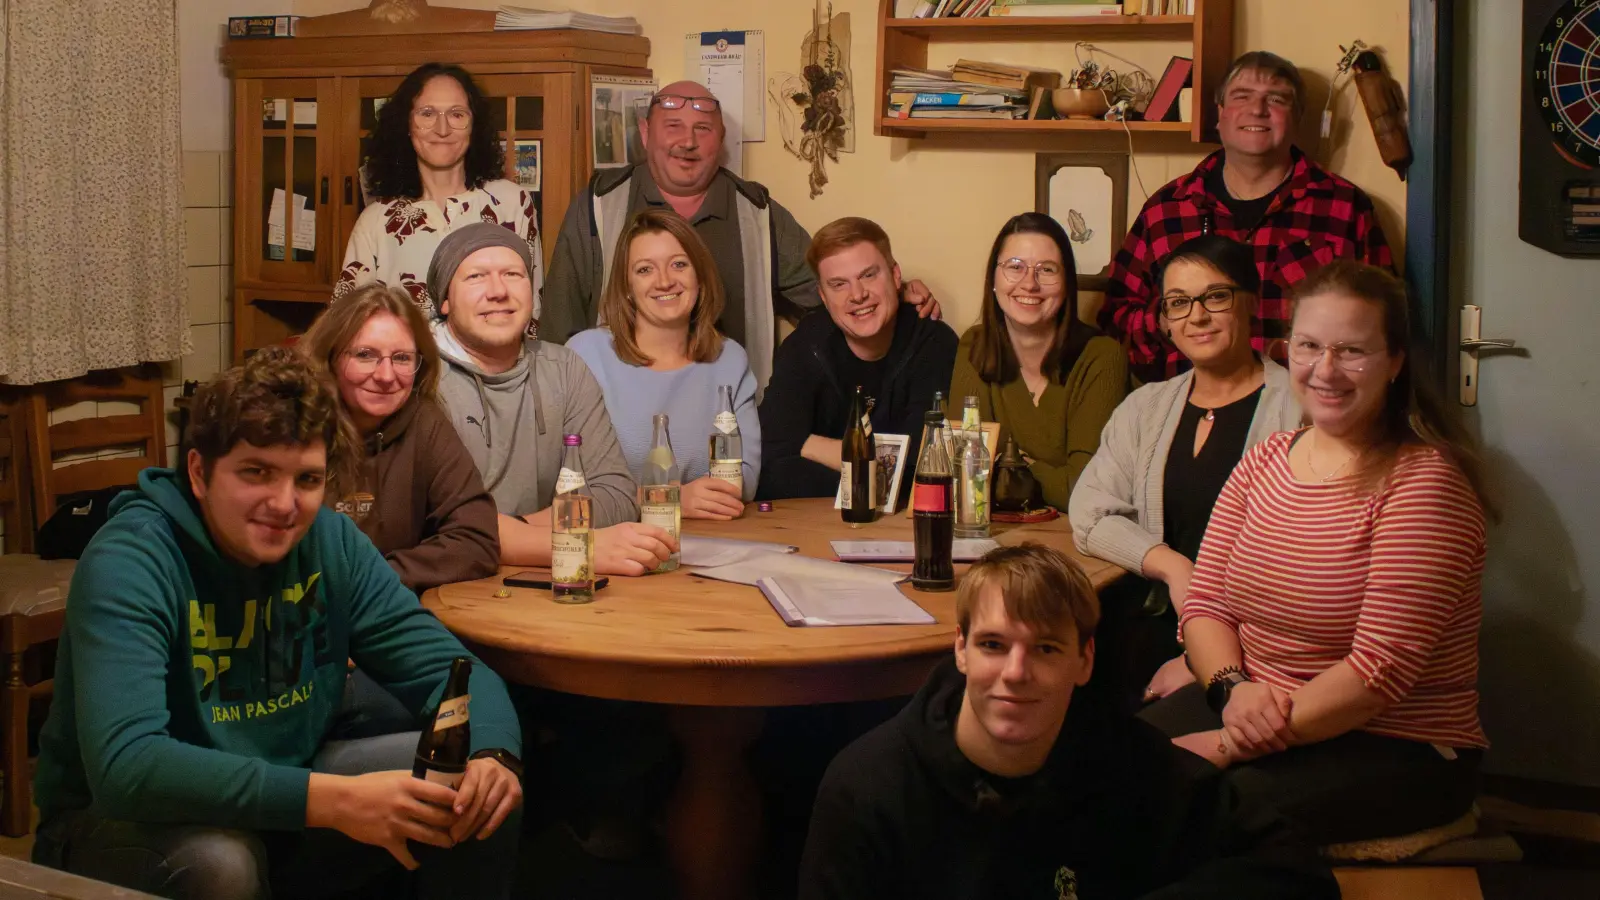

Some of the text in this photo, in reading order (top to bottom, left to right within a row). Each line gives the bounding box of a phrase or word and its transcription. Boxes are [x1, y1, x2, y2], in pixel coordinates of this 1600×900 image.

[1556, 17, 1563, 28] 9
[1539, 43, 1552, 52] 14
[1535, 71, 1547, 79] 11
[1541, 97, 1549, 107] 8
[1551, 122, 1564, 132] 16
[1575, 142, 1582, 152] 7
[211, 705, 241, 724] JEAN
